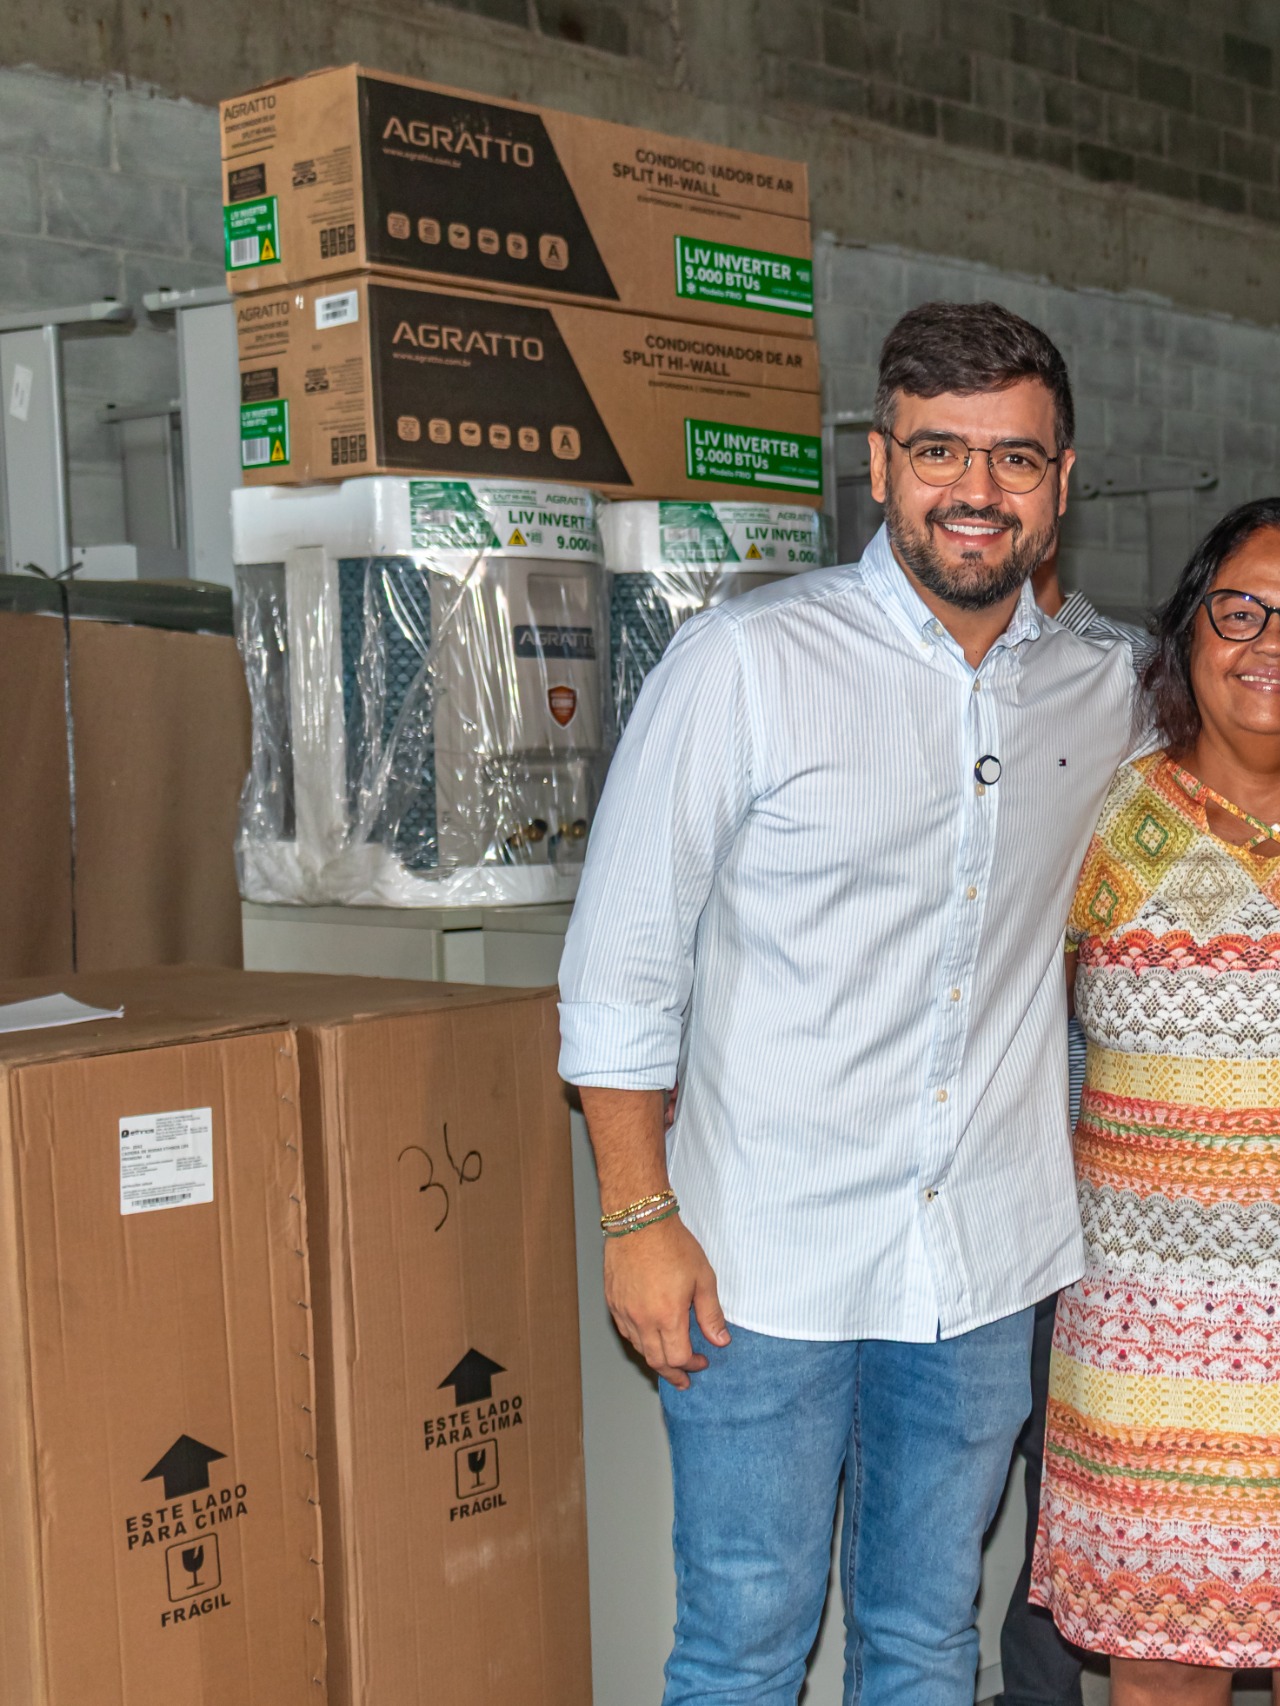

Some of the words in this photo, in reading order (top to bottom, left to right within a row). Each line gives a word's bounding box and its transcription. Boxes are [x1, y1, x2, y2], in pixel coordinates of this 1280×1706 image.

[382, 116, 534, 167] AGRATTO
[612, 163, 654, 184] SPLIT
[657, 172, 720, 197] HI-WALL
[756, 174, 774, 190] DE
[777, 179, 794, 194] AR
[685, 246, 711, 266] LIV
[714, 251, 791, 281] INVERTER
[685, 264, 724, 285] 9.000
[725, 271, 761, 291] BTUs
[392, 320, 544, 362] AGRATTO
[645, 335, 763, 364] CONDICIONADOR
[766, 352, 783, 366] DE
[786, 355, 802, 368] AR
[623, 350, 664, 369] SPLIT
[668, 357, 730, 377] HI-WALL
[695, 428, 720, 447] LIV
[723, 433, 800, 459] INVERTER
[695, 447, 732, 465] 9.000
[734, 452, 769, 470] BTUs
[545, 494, 589, 506] AGRATT
[508, 510, 535, 525] LIV
[746, 527, 770, 540] LIV
[398, 1122, 482, 1232] 36
[424, 1410, 471, 1436] ESTE
[477, 1395, 523, 1421] LADO
[425, 1426, 473, 1451] PARA
[479, 1412, 523, 1435] CIMA
[125, 1502, 183, 1533] ESTE
[192, 1484, 247, 1514] LADO
[450, 1493, 507, 1522] FRÁGIL
[127, 1521, 187, 1550] PARA
[195, 1501, 248, 1530] CIMA
[161, 1593, 231, 1628] FRÁGIL
